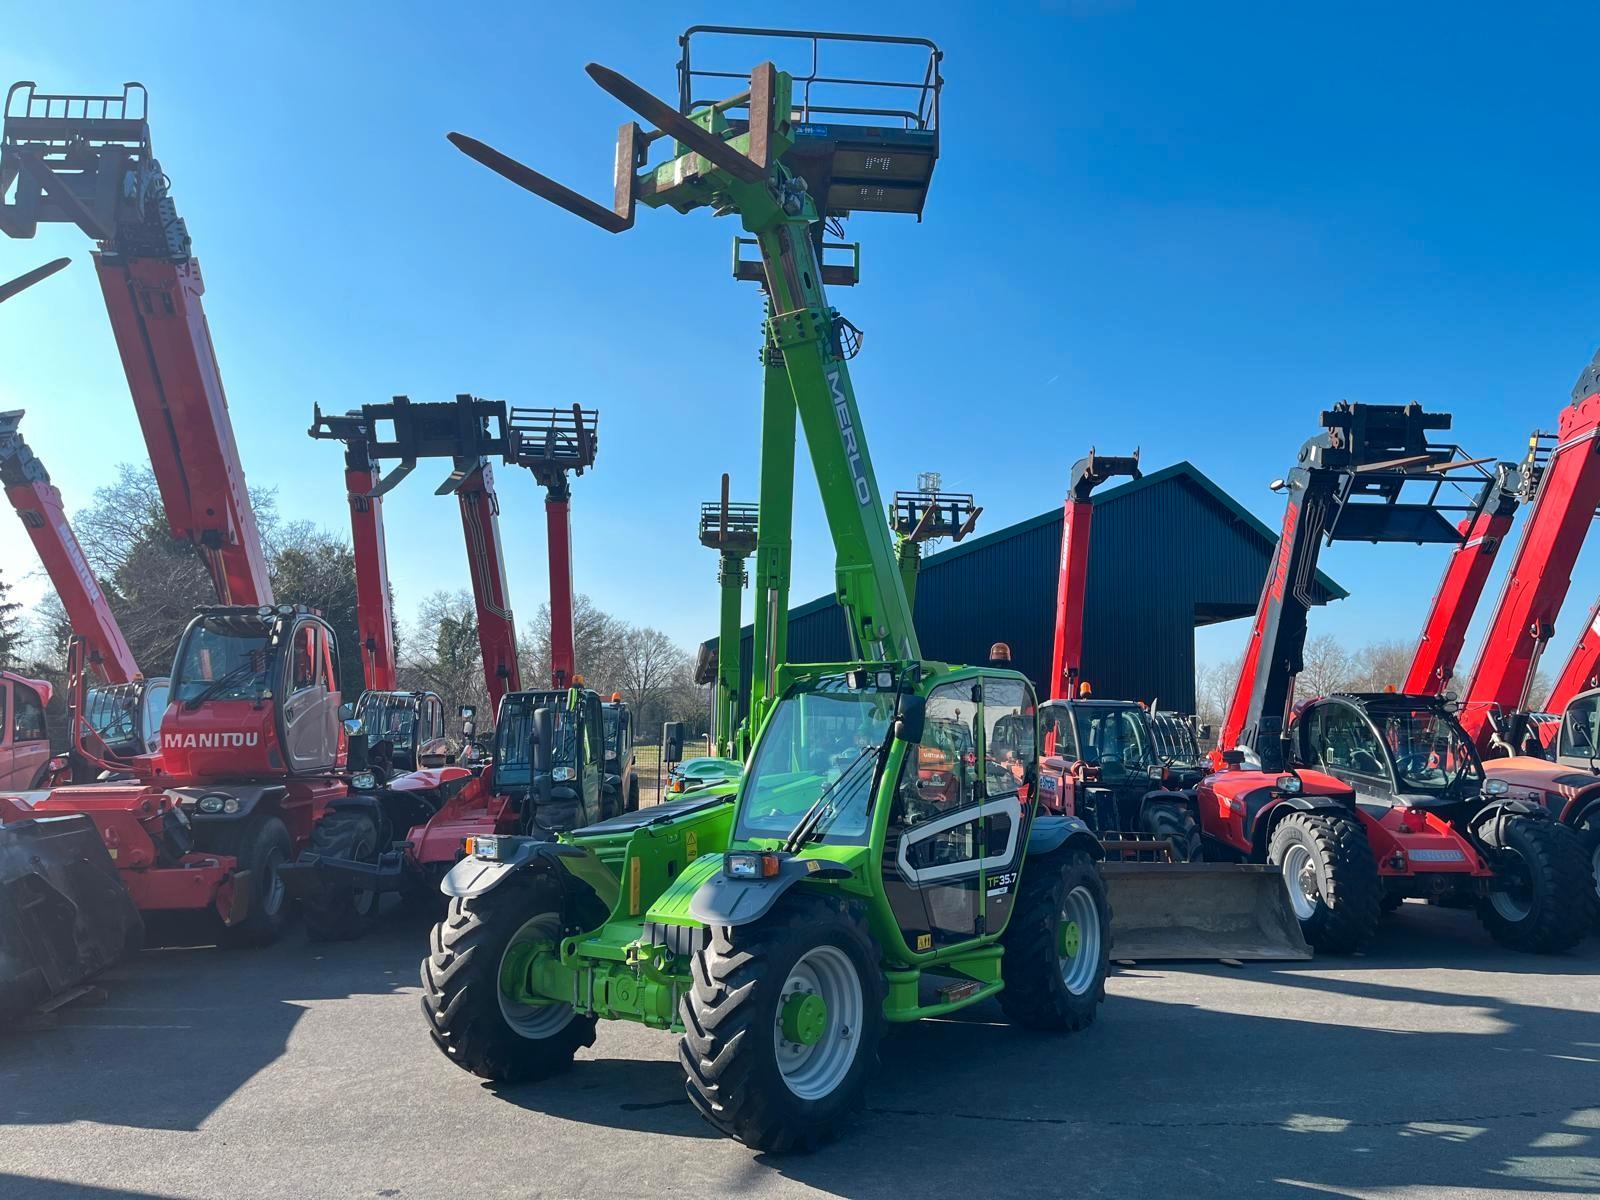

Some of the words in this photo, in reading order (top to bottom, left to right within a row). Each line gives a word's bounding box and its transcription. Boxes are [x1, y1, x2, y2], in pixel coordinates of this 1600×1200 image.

[827, 371, 870, 505] MERLO
[1272, 502, 1298, 602] MANITOU
[164, 732, 258, 748] MANITOU
[987, 872, 1017, 887] TF35.7
